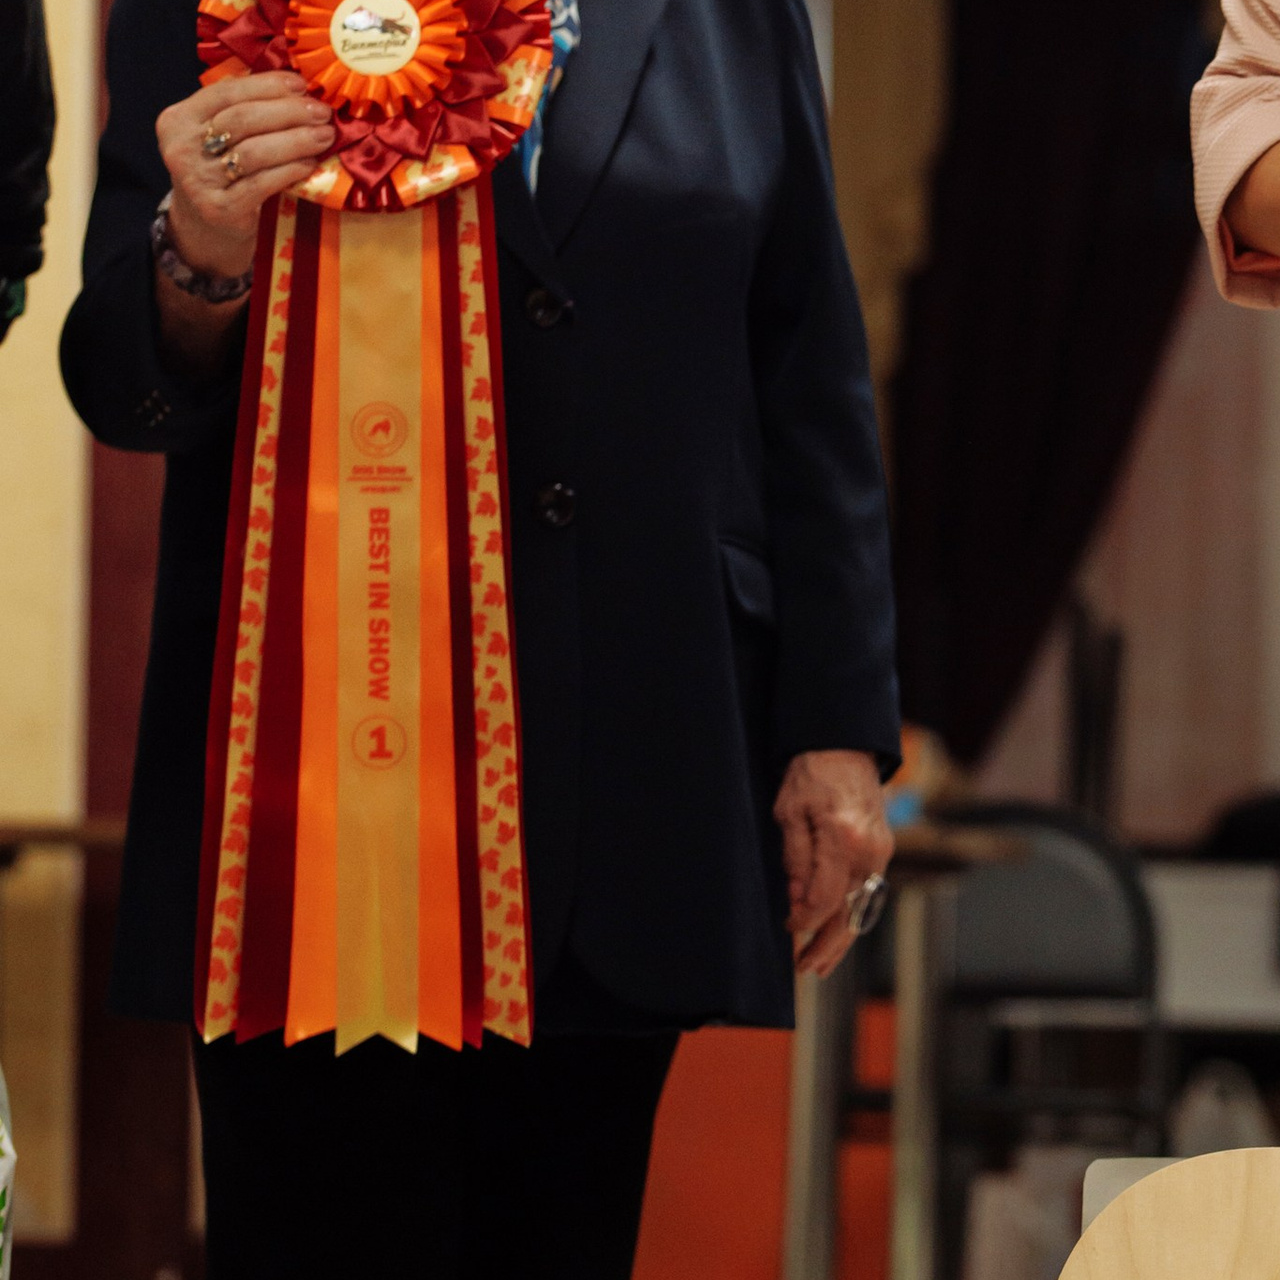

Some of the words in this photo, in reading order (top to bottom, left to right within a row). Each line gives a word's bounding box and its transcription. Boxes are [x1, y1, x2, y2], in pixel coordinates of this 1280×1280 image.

[368, 507, 390, 574] BEST
[368, 582, 390, 610] IN
[367, 617, 390, 701] SHOW
[368, 725, 394, 760] 1
